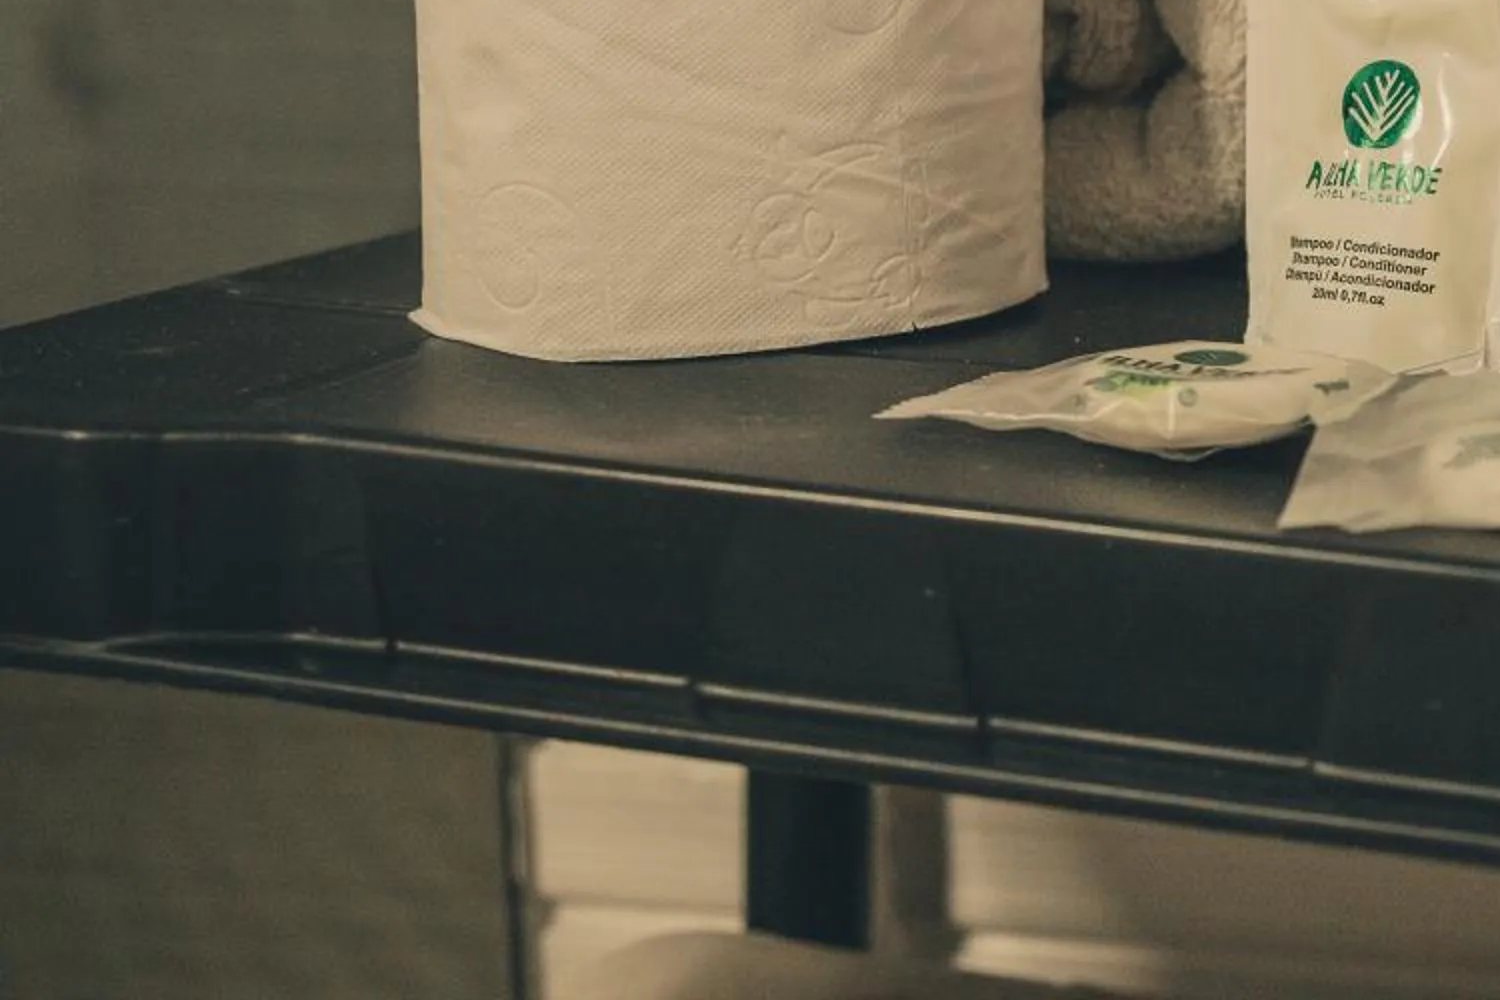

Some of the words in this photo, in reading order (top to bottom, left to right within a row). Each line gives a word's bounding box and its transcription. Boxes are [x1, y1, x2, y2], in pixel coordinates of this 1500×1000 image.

[1367, 160, 1443, 195] VERDE
[1342, 238, 1441, 263] Condicionador
[1349, 255, 1429, 277] Conditioner
[1330, 270, 1437, 295] Acondicionador
